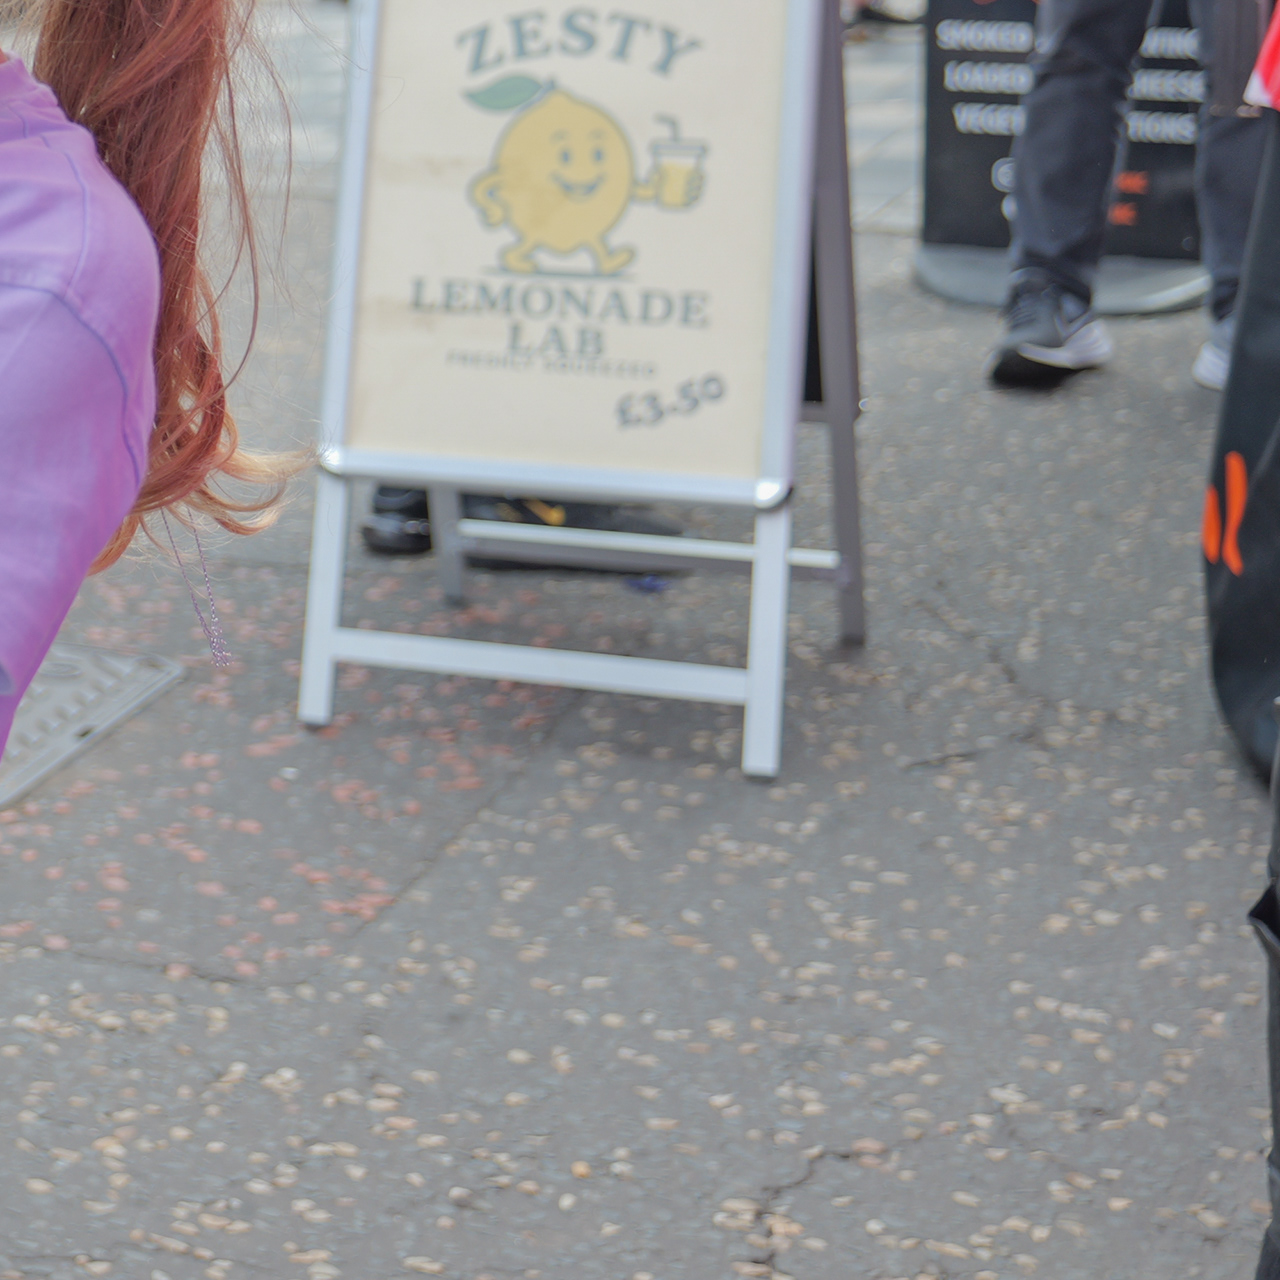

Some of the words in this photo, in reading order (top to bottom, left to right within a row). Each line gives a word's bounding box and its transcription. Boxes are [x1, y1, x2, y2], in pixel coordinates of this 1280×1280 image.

[456, 6, 702, 77] ZESTY
[937, 19, 1034, 53] SMOKED
[944, 60, 1034, 94] LOADED
[409, 277, 711, 326] LEMONADE
[506, 322, 606, 356] LAB
[615, 373, 726, 428] £3.50
